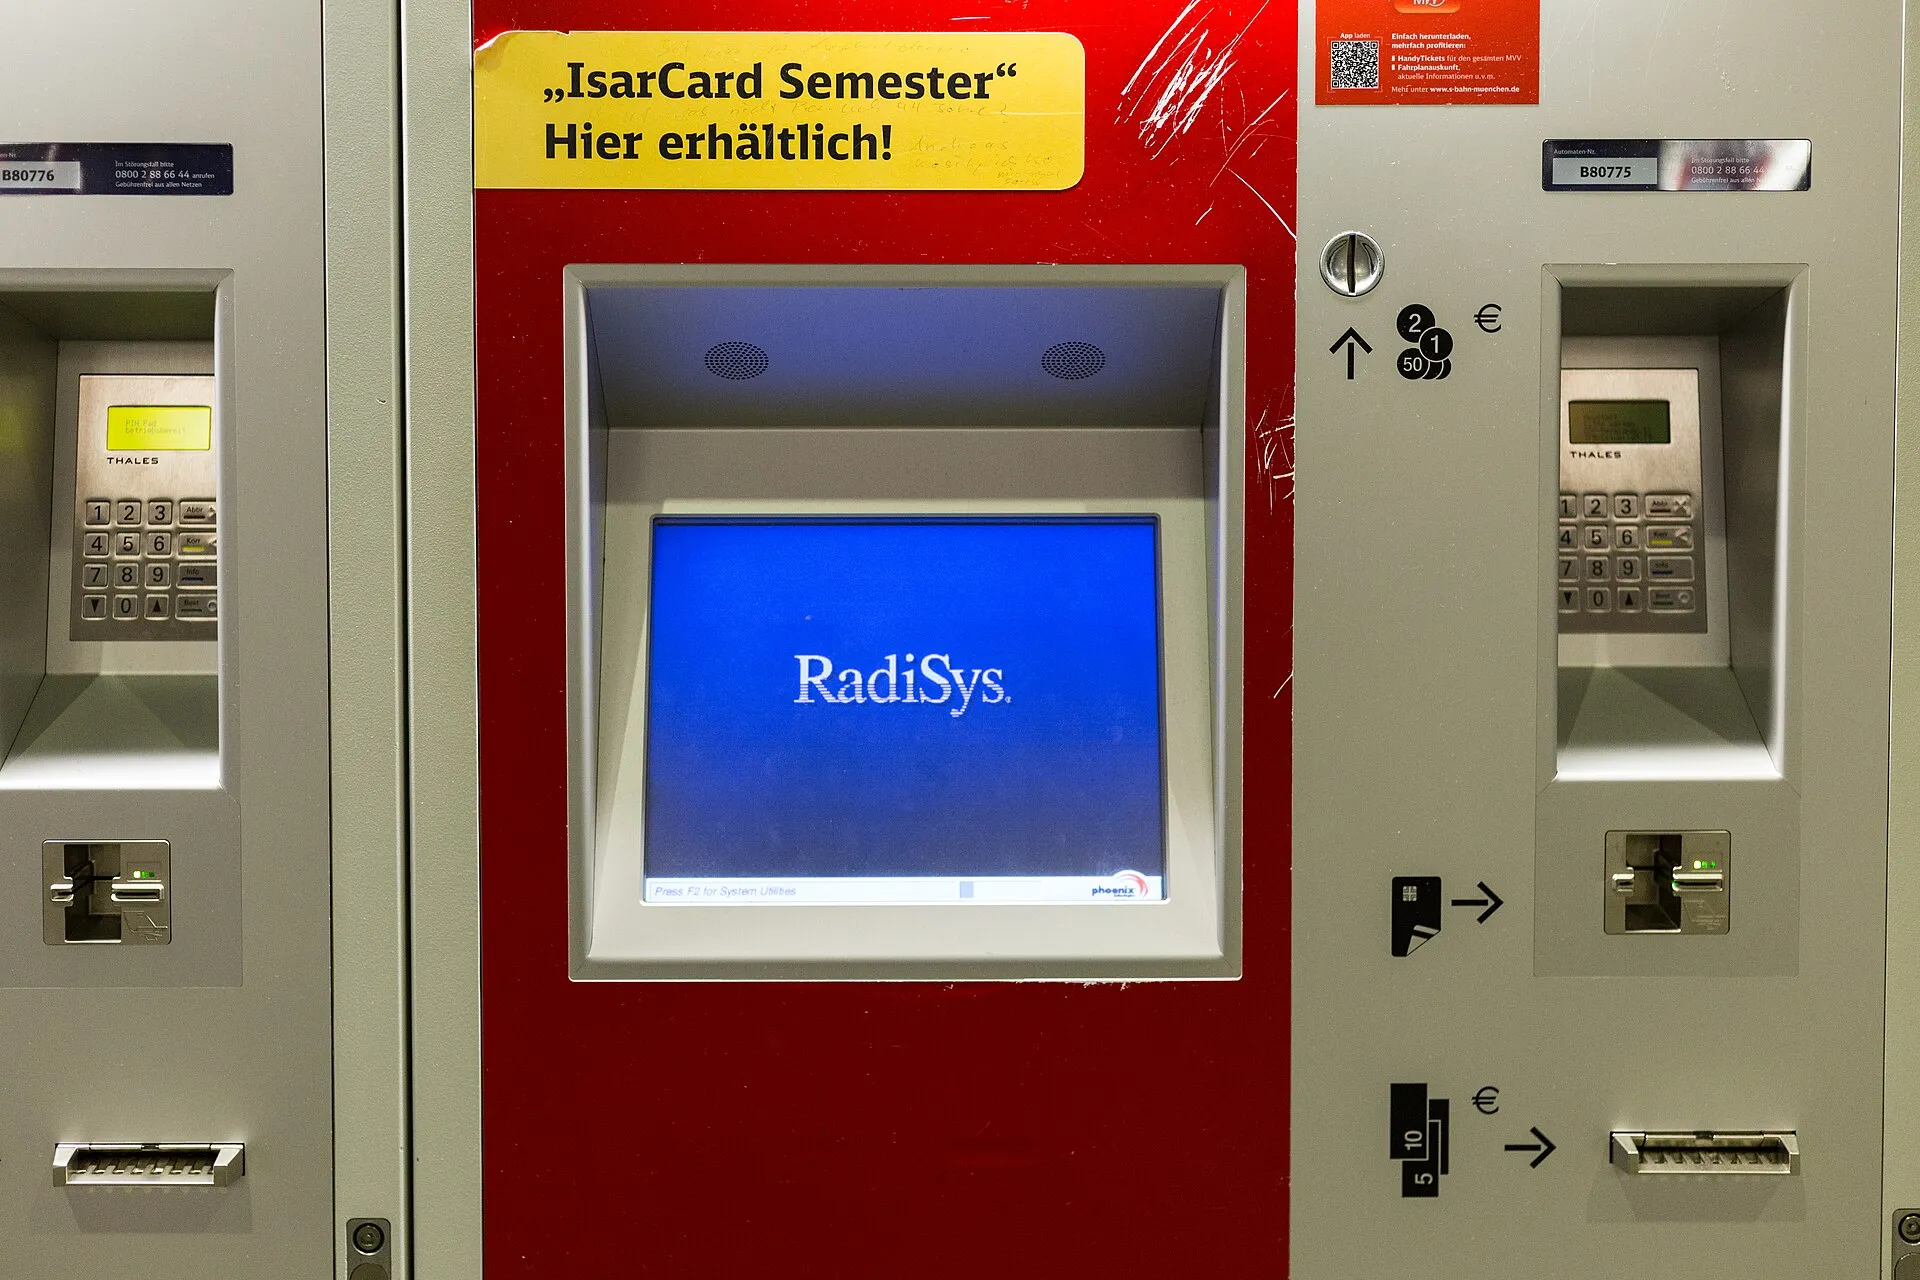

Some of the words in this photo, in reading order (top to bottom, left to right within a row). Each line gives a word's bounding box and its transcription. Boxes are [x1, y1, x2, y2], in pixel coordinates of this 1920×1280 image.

[1340, 32, 1353, 40] App
[1419, 33, 1472, 41] herunterladen,
[1426, 42, 1466, 50] profitieren:
[1397, 55, 1446, 63] HandyTickets
[1397, 64, 1461, 72] Fahrplanauskunft,
[543, 62, 763, 103] „IsarCard
[780, 62, 1018, 99] Semester“
[544, 123, 642, 160] Hier
[658, 122, 894, 160] erhältlich!
[2, 170, 55, 182] B80776
[115, 170, 139, 179] 0800
[141, 170, 147, 179] 2
[149, 170, 161, 179] 88
[163, 170, 176, 179] 66
[178, 170, 190, 179] 44
[1580, 166, 1632, 179] B80775
[1691, 166, 1714, 174] 0800
[1716, 166, 1722, 174] 2
[1724, 166, 1737, 174] 88
[1739, 166, 1751, 174] 66
[1753, 166, 1764, 174] 44
[1408, 313, 1422, 333] 2
[1430, 335, 1439, 353] 1
[1403, 357, 1422, 371] 50
[107, 457, 159, 465] THALES
[1570, 451, 1622, 459] THALES
[94, 505, 101, 521] 1
[124, 505, 134, 520] 2
[154, 505, 165, 520] 3
[1561, 500, 1568, 514] 1
[1591, 499, 1601, 514] 2
[1621, 499, 1631, 514] 3
[91, 536, 103, 551] 4
[123, 535, 133, 550] 5
[153, 536, 165, 550] 6
[1560, 530, 1571, 545] 4
[1591, 530, 1602, 545] 5
[1622, 530, 1632, 545] 6
[91, 567, 102, 582] 7
[121, 567, 132, 582] 8
[152, 567, 164, 582] 9
[1561, 561, 1571, 576] 7
[1592, 561, 1603, 576] 8
[1623, 560, 1634, 576] 9
[120, 599, 131, 614] 0
[1593, 593, 1604, 607] 0
[655, 886, 683, 896] Press
[687, 886, 699, 896] F2
[703, 886, 717, 896] for
[719, 886, 757, 898] System
[760, 886, 796, 896] Utilities
[1092, 885, 1134, 896] phoenix
[1404, 1130, 1423, 1150] 10
[1414, 1172, 1433, 1185] 5
